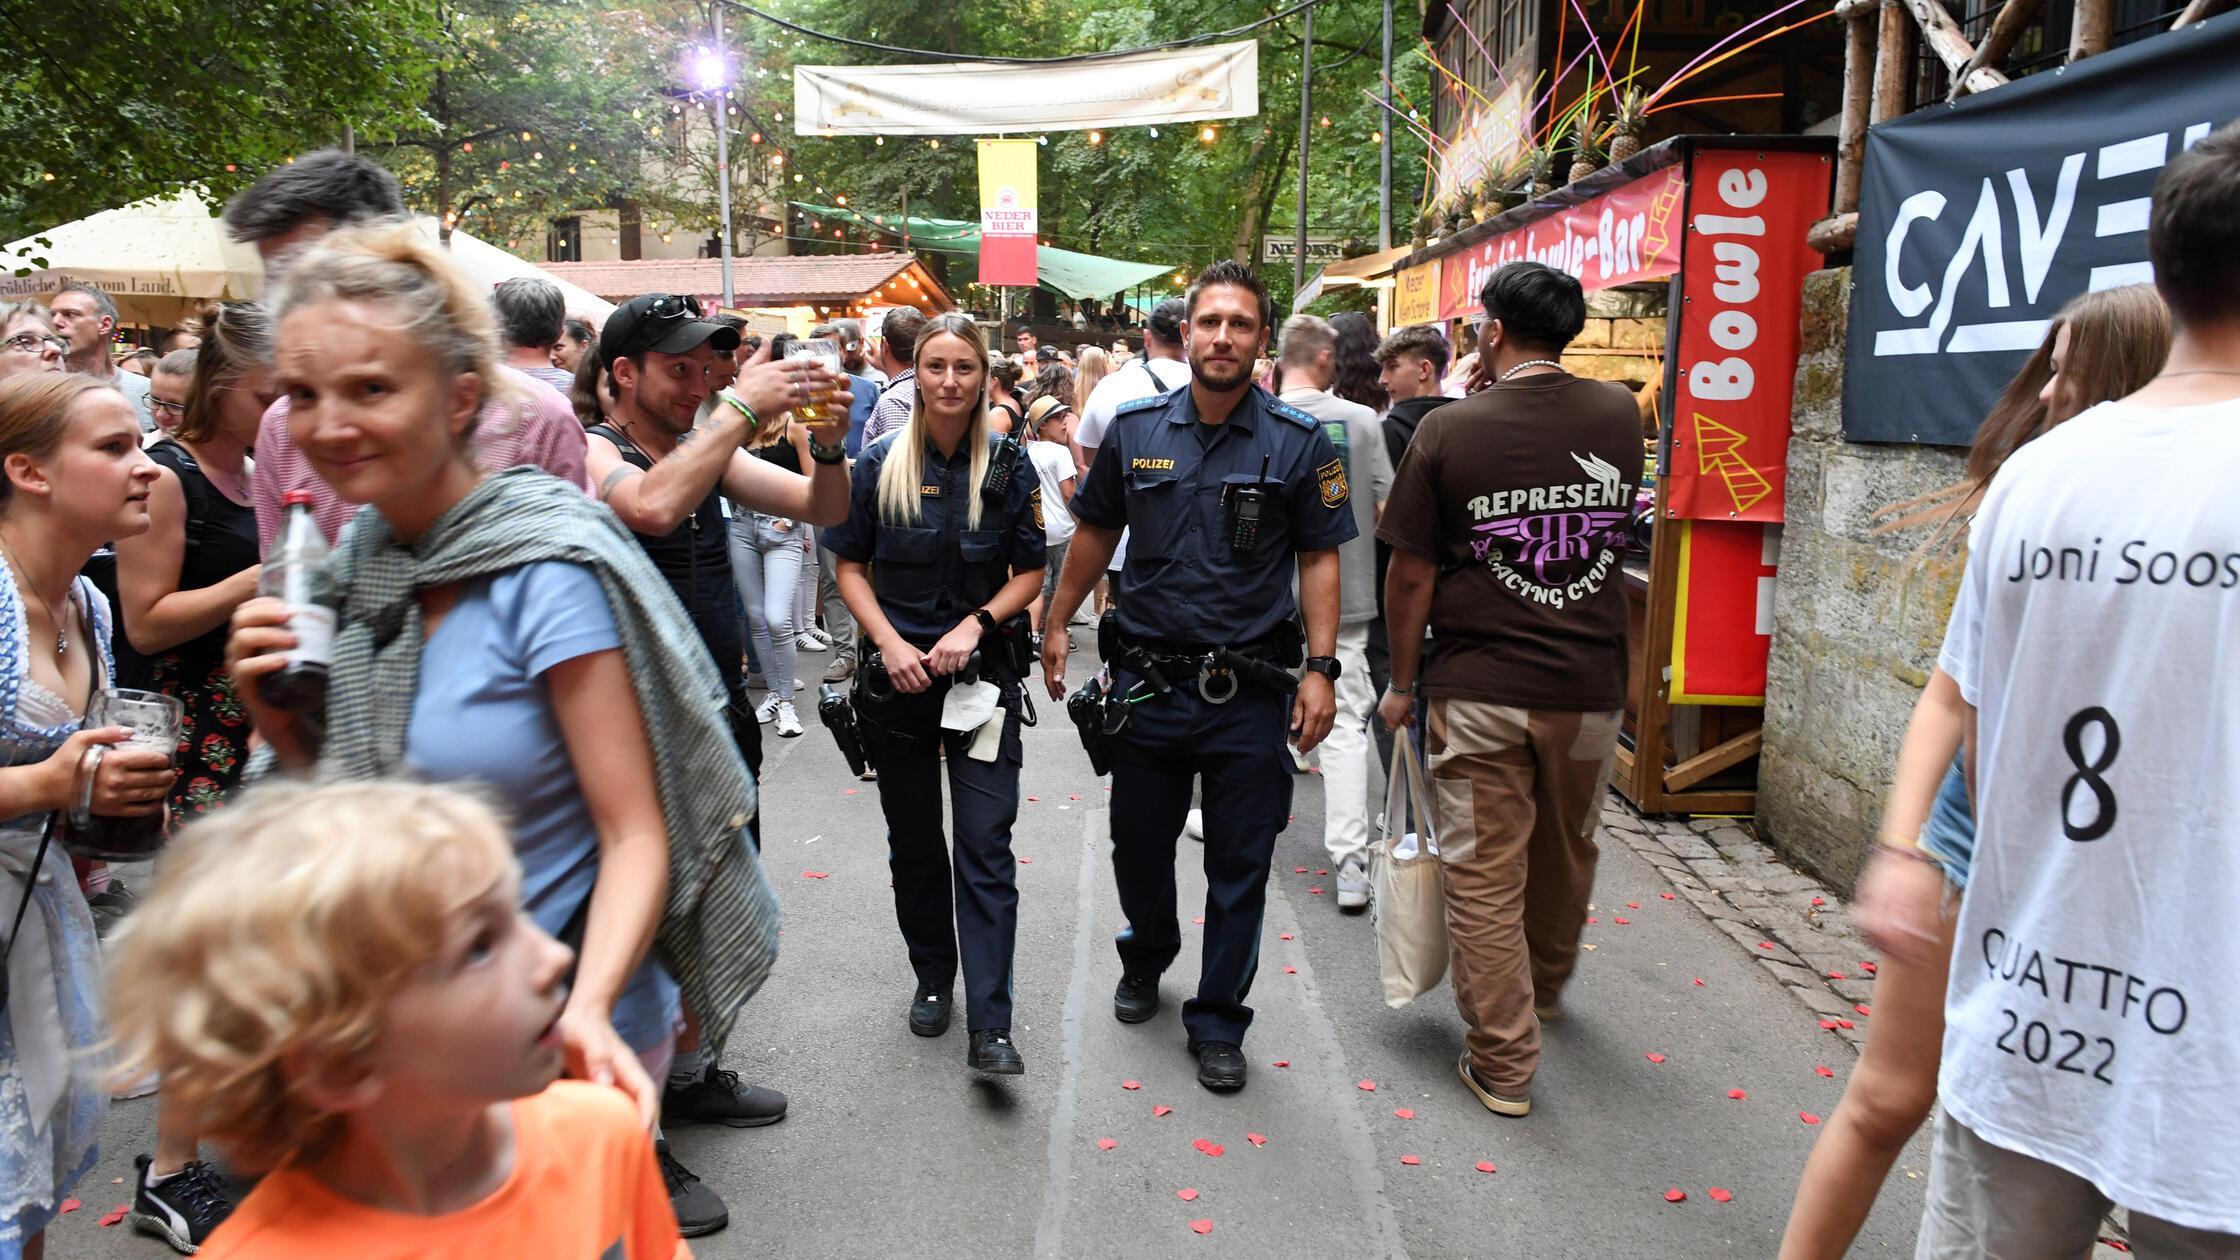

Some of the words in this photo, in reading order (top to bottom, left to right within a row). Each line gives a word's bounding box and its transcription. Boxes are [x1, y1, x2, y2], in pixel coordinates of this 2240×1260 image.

[985, 211, 1032, 220] NEDER
[992, 221, 1025, 230] BIER
[1874, 122, 2211, 357] CAVE
[1689, 168, 1768, 400] Bowle
[1132, 458, 1175, 470] POLIZEI
[1467, 478, 1632, 520] REPRESENT
[1486, 548, 1564, 609] RACING
[1567, 549, 1615, 601] CLUB
[2008, 537, 2102, 583] Joni
[2114, 540, 2240, 589] Soos
[2060, 705, 2121, 842] 8
[1995, 1009, 2116, 1085] 2022
